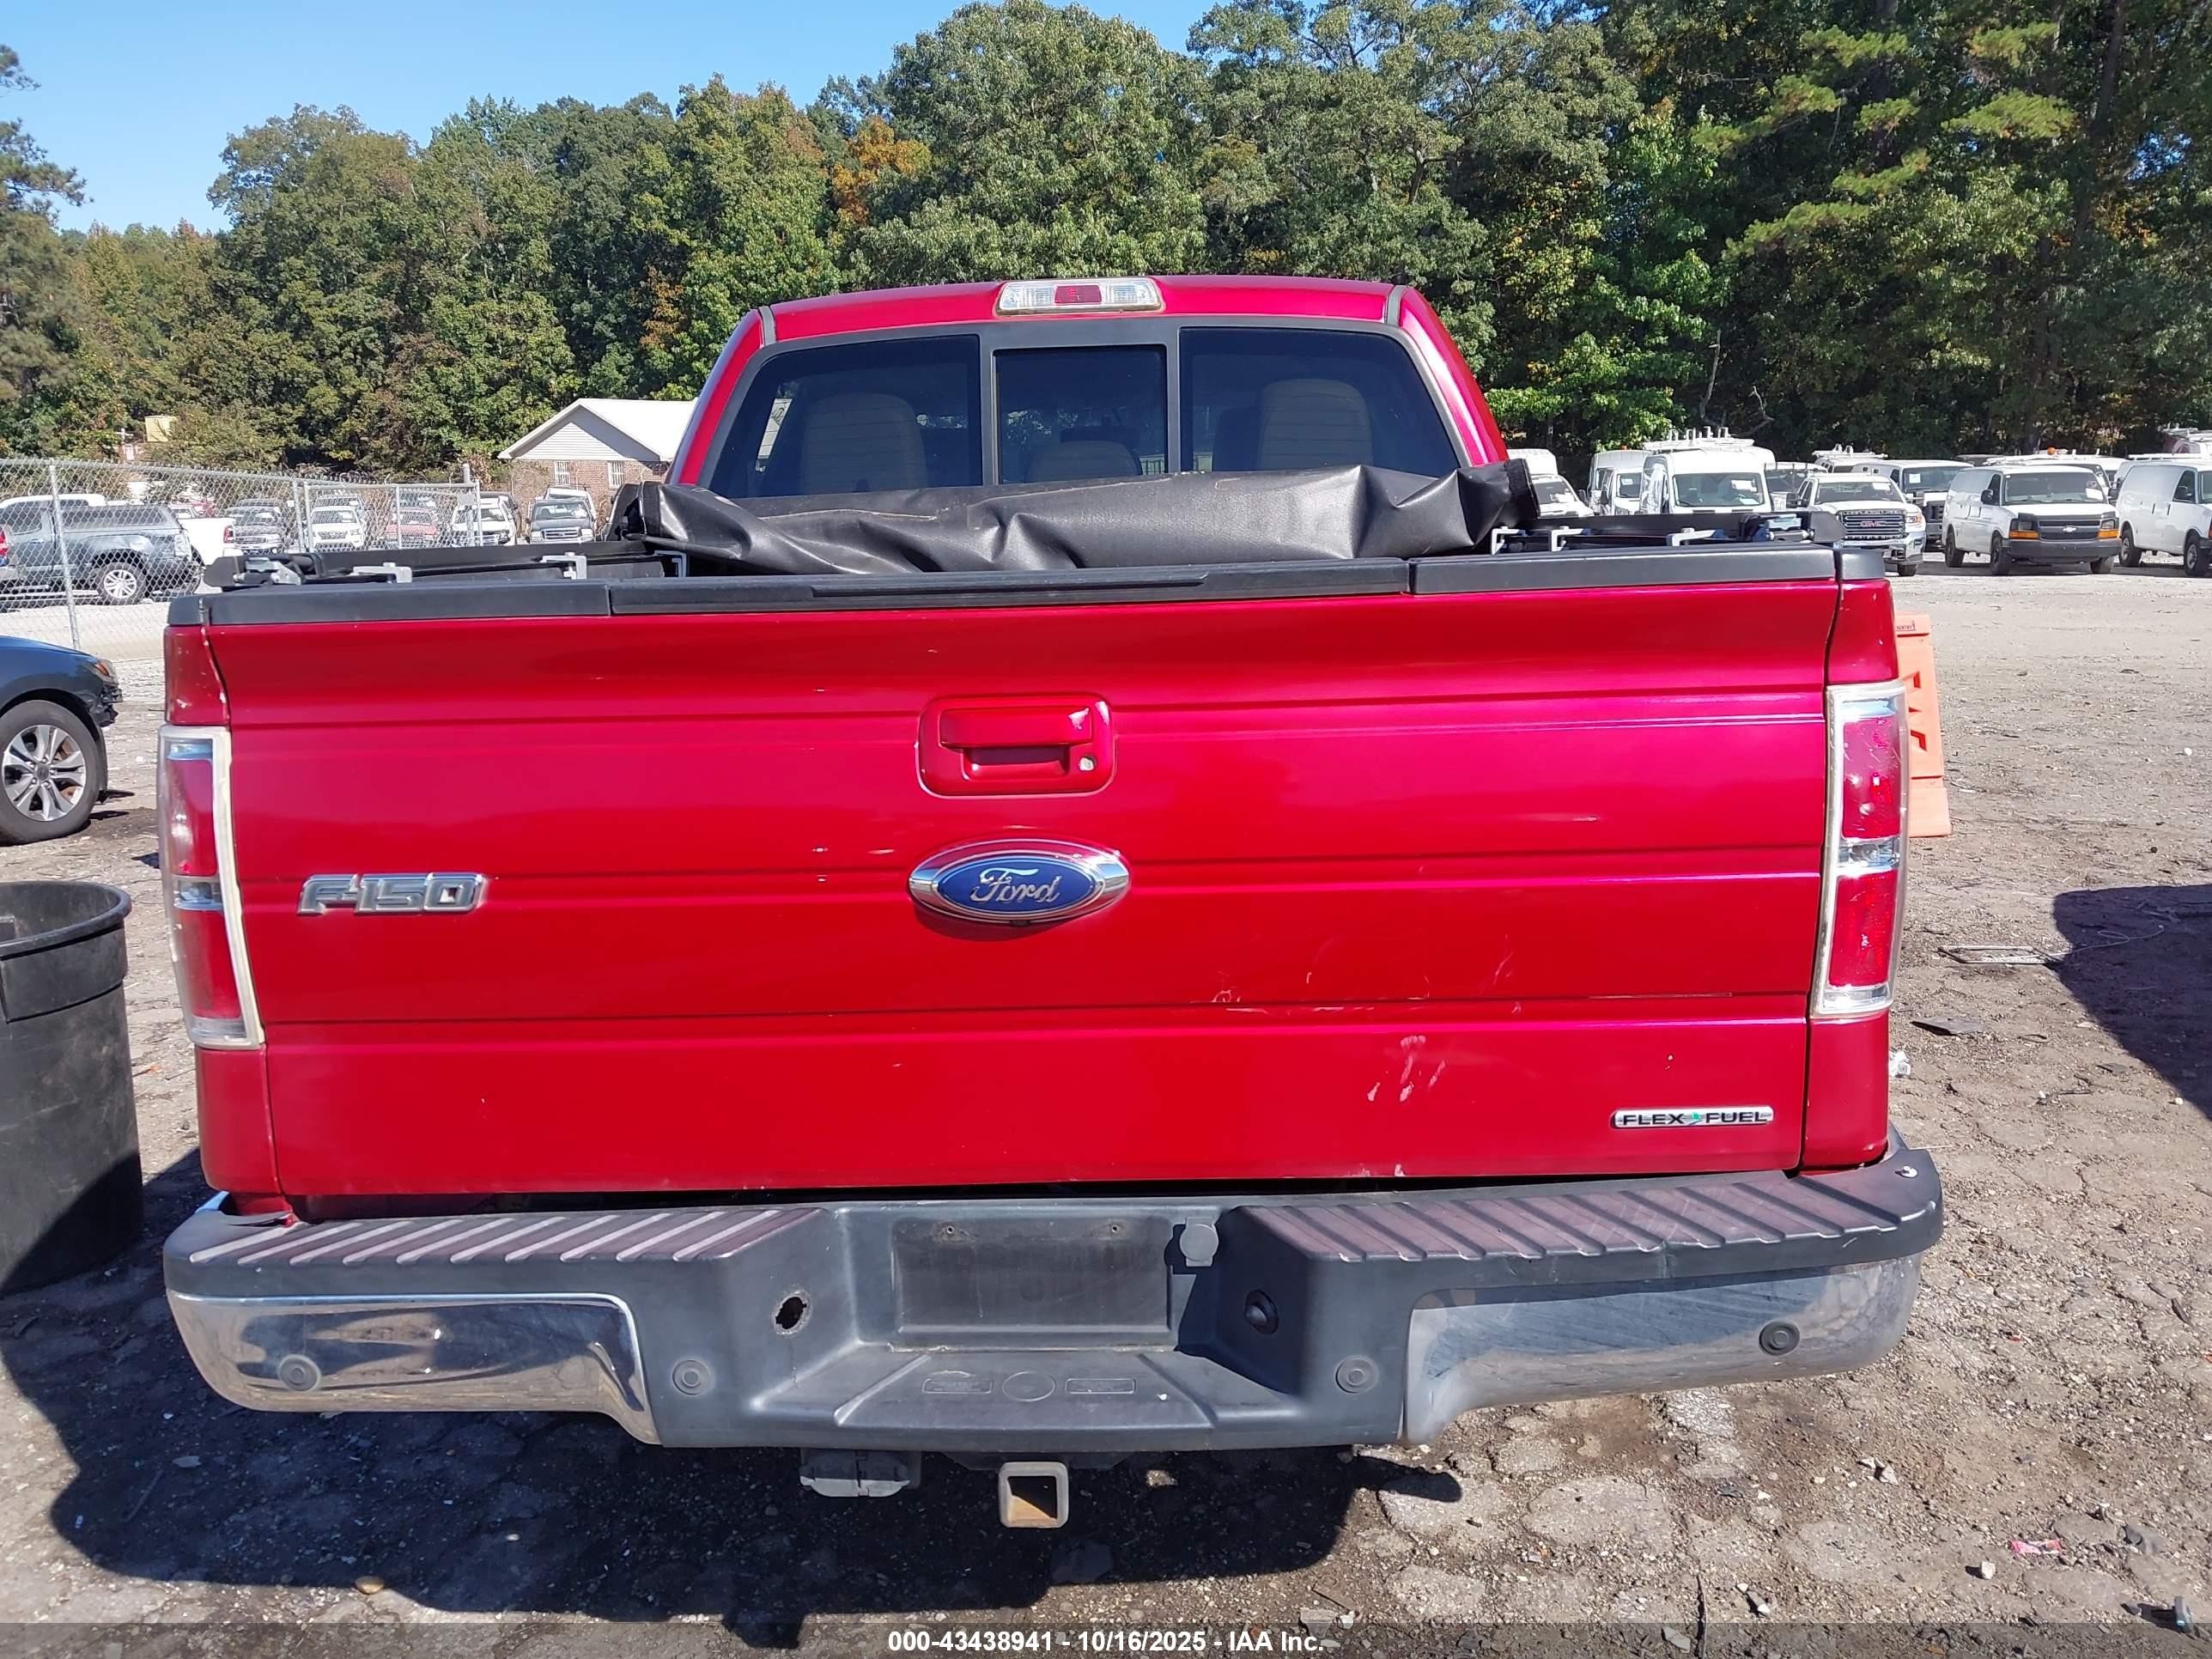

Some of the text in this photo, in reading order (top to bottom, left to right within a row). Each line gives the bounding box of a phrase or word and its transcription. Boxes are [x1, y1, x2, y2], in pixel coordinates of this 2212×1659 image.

[970, 867, 1062, 902] Ford
[1622, 1111, 1767, 1126] FLEX FUEL
